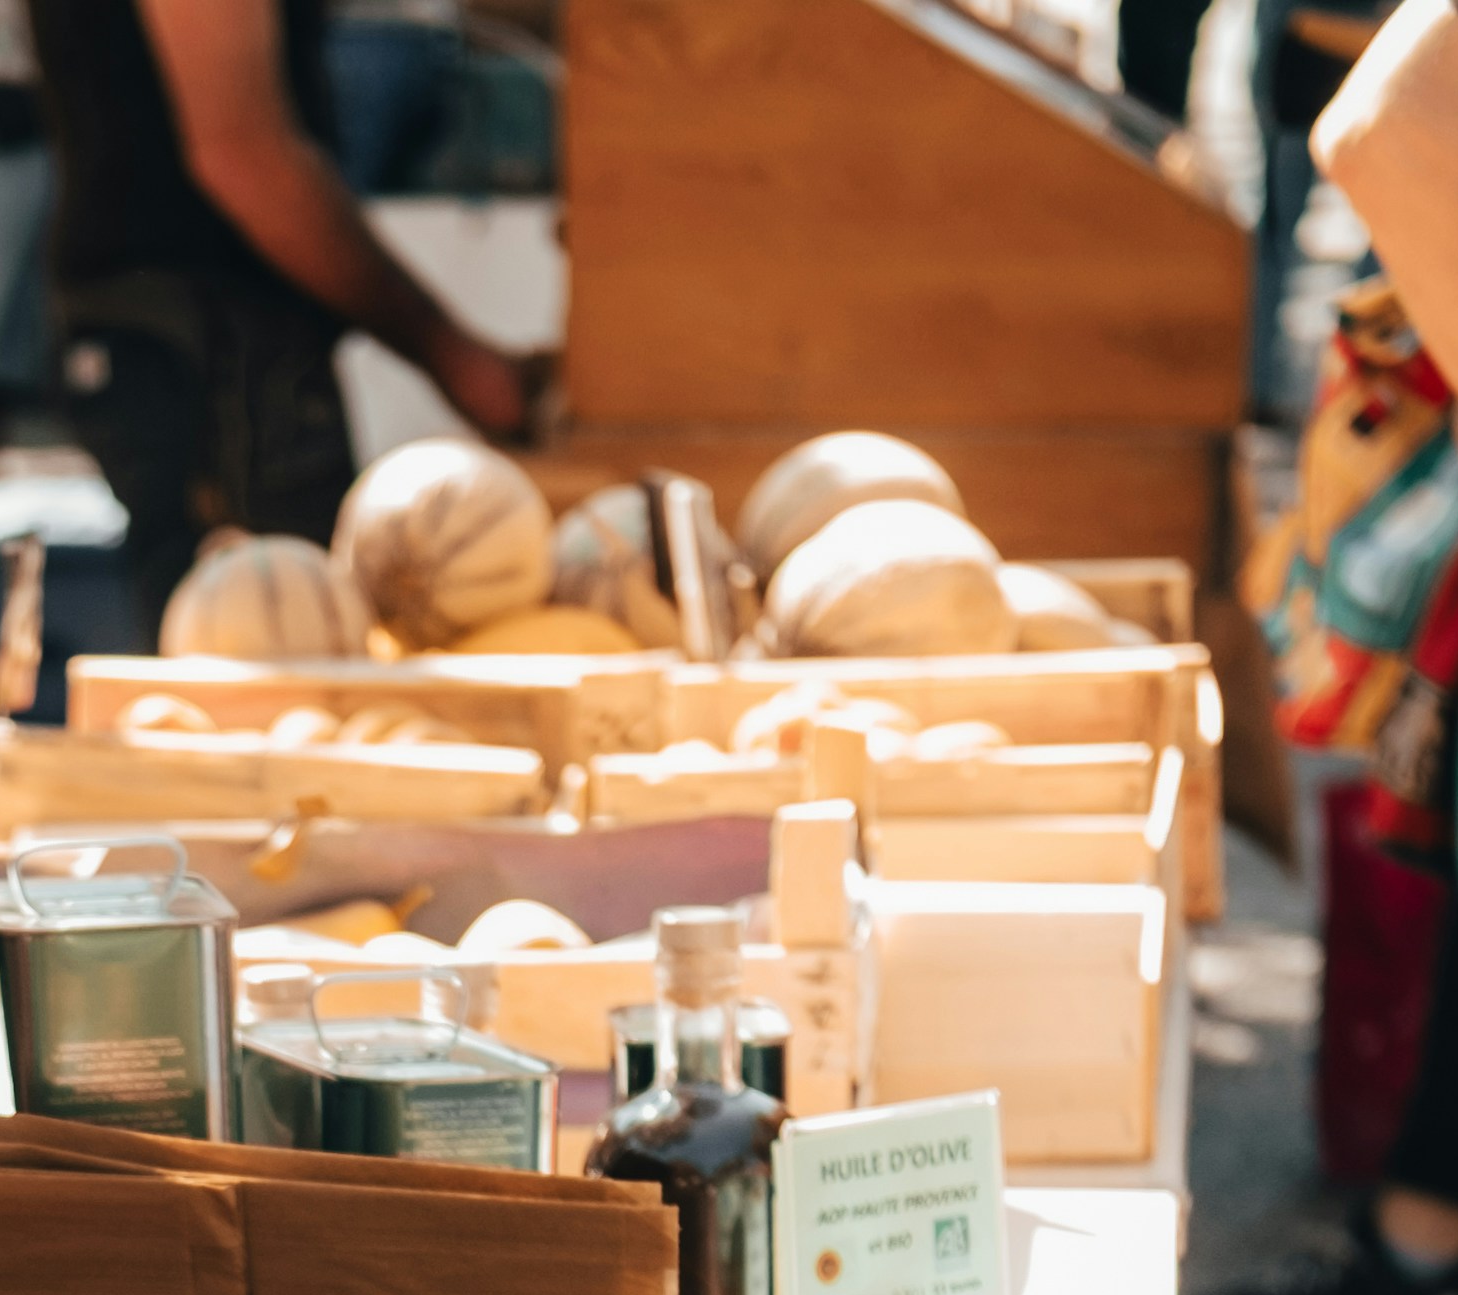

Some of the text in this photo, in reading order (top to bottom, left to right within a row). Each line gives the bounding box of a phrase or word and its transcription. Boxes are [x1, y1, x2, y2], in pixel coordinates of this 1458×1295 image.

[820, 1138, 972, 1183] HUILE D'OLIVE
[818, 1206, 848, 1226] AOP
[852, 1199, 899, 1220] HAUTE
